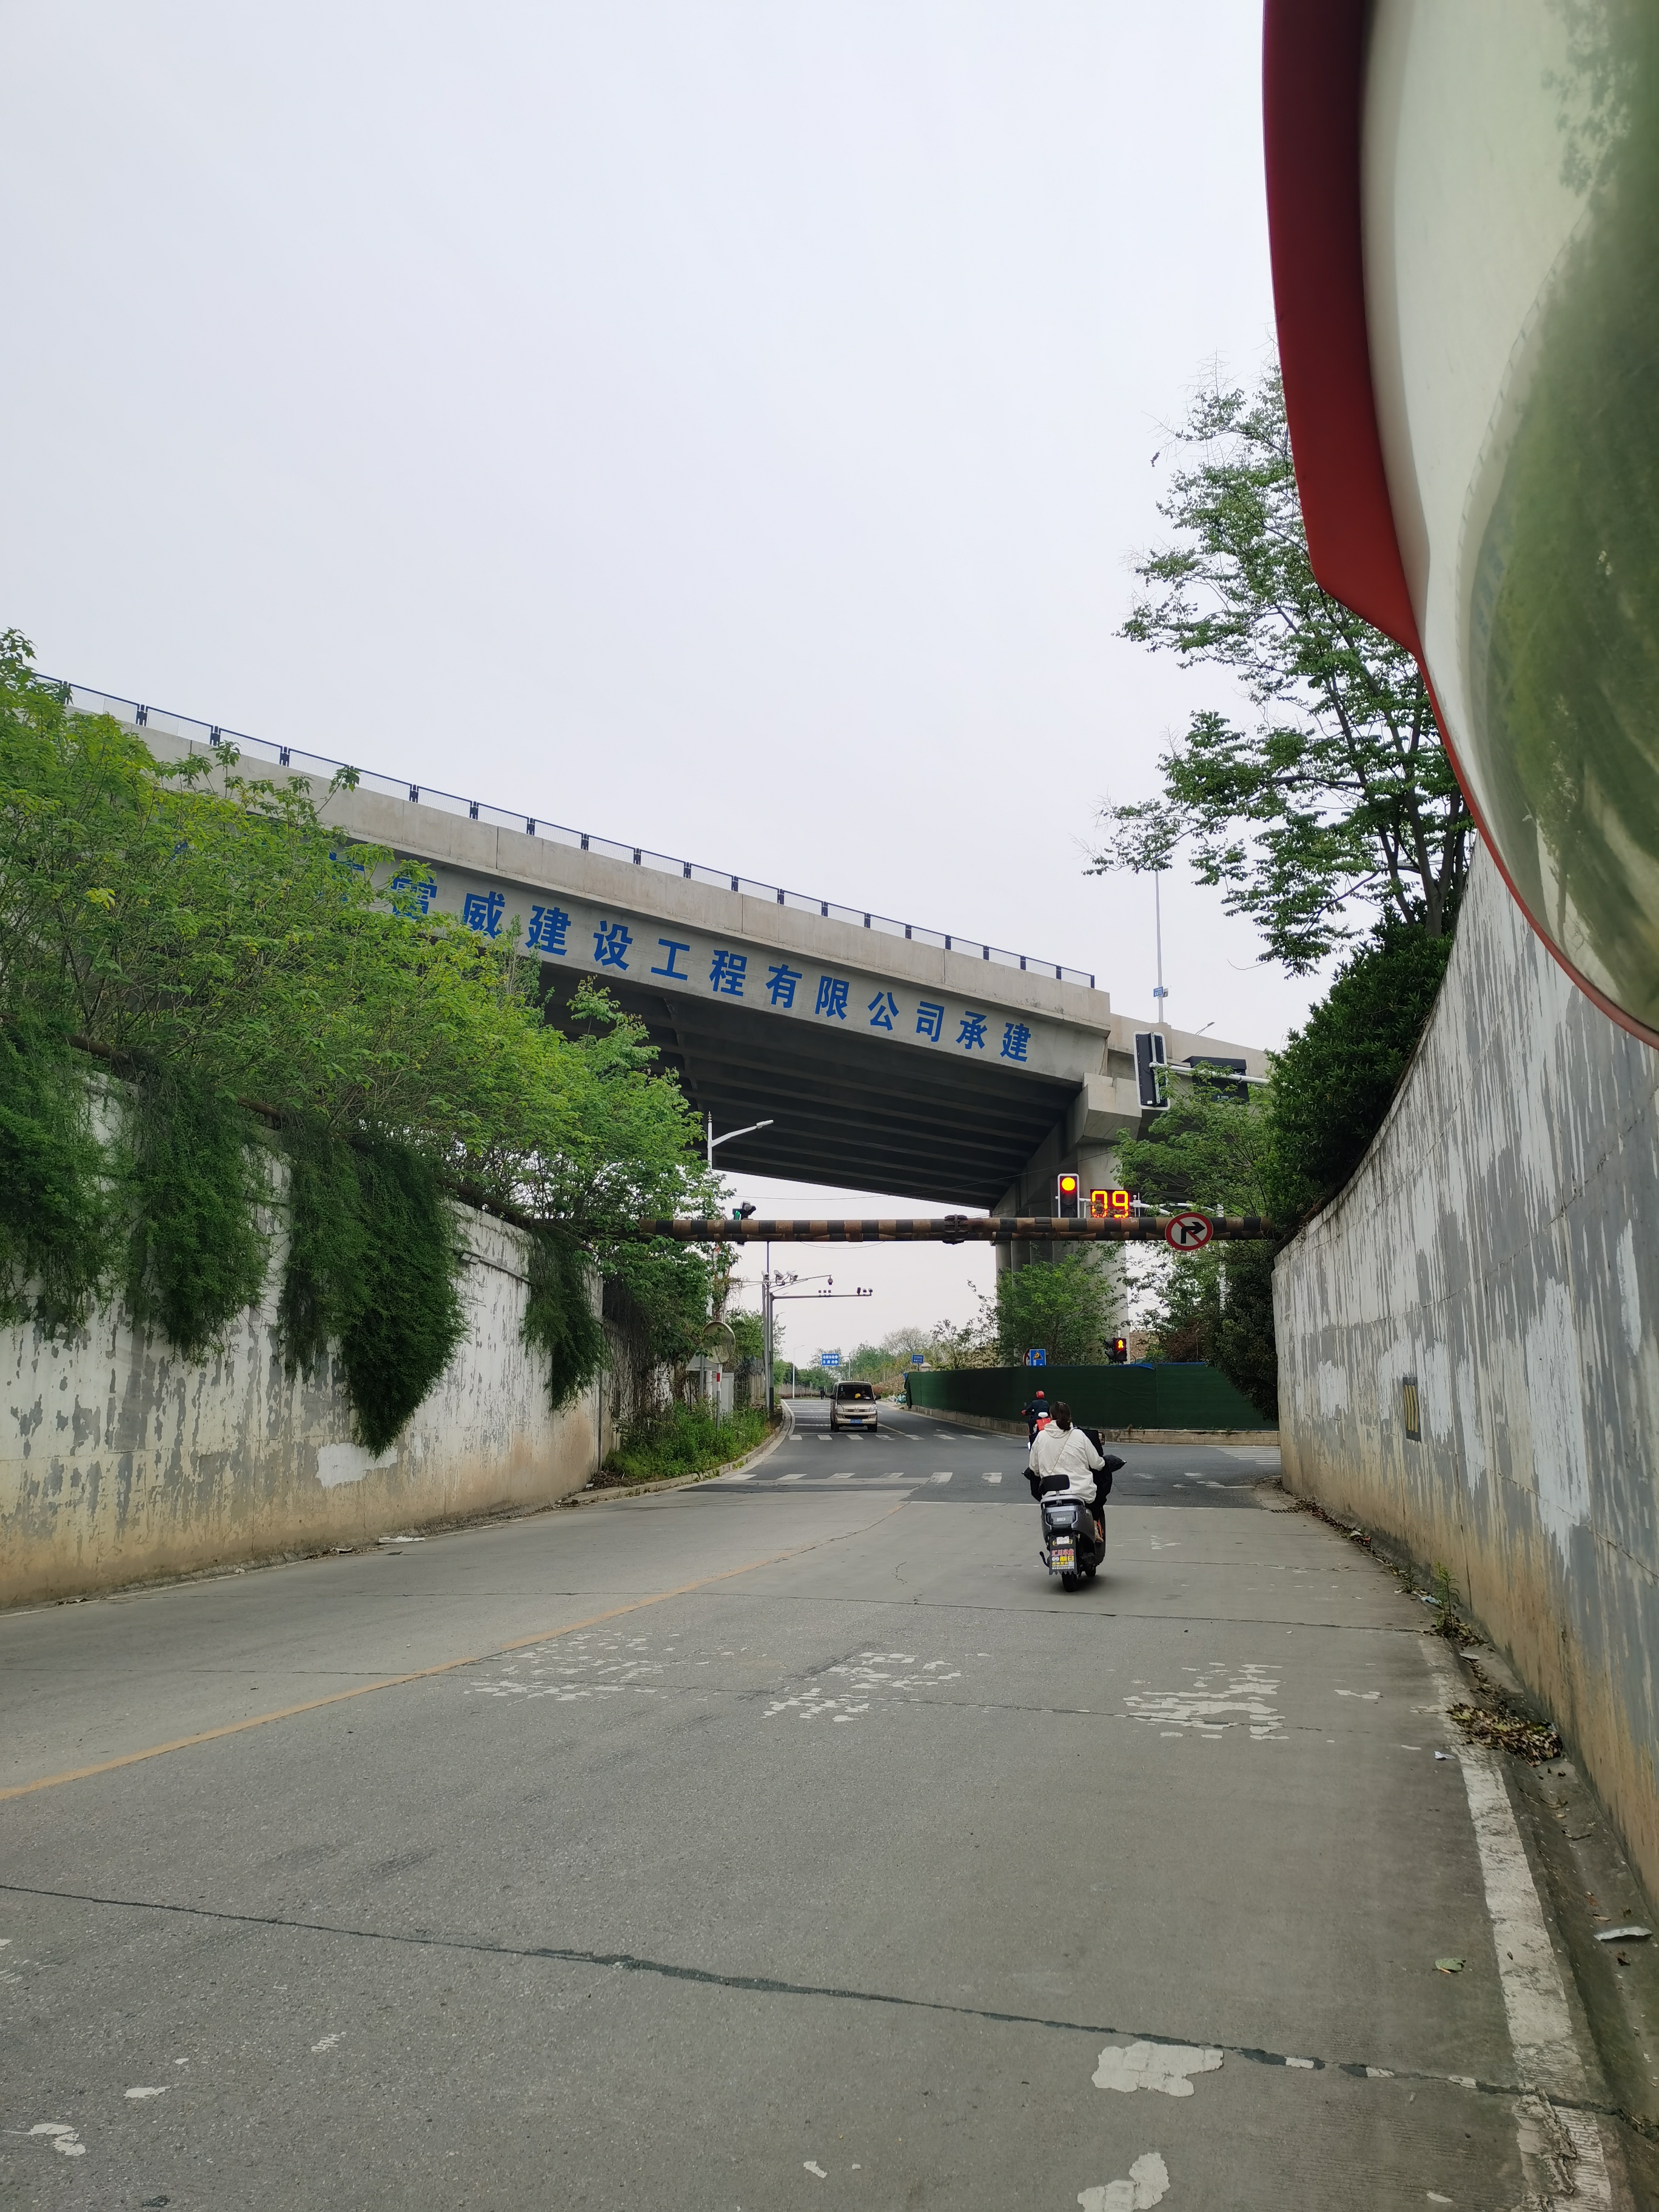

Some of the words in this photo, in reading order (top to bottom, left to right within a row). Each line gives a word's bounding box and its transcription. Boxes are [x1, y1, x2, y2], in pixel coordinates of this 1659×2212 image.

[328, 852, 1031, 1062] 雷威建设工程有限公司承建
[1091, 1190, 1129, 1218] 09
